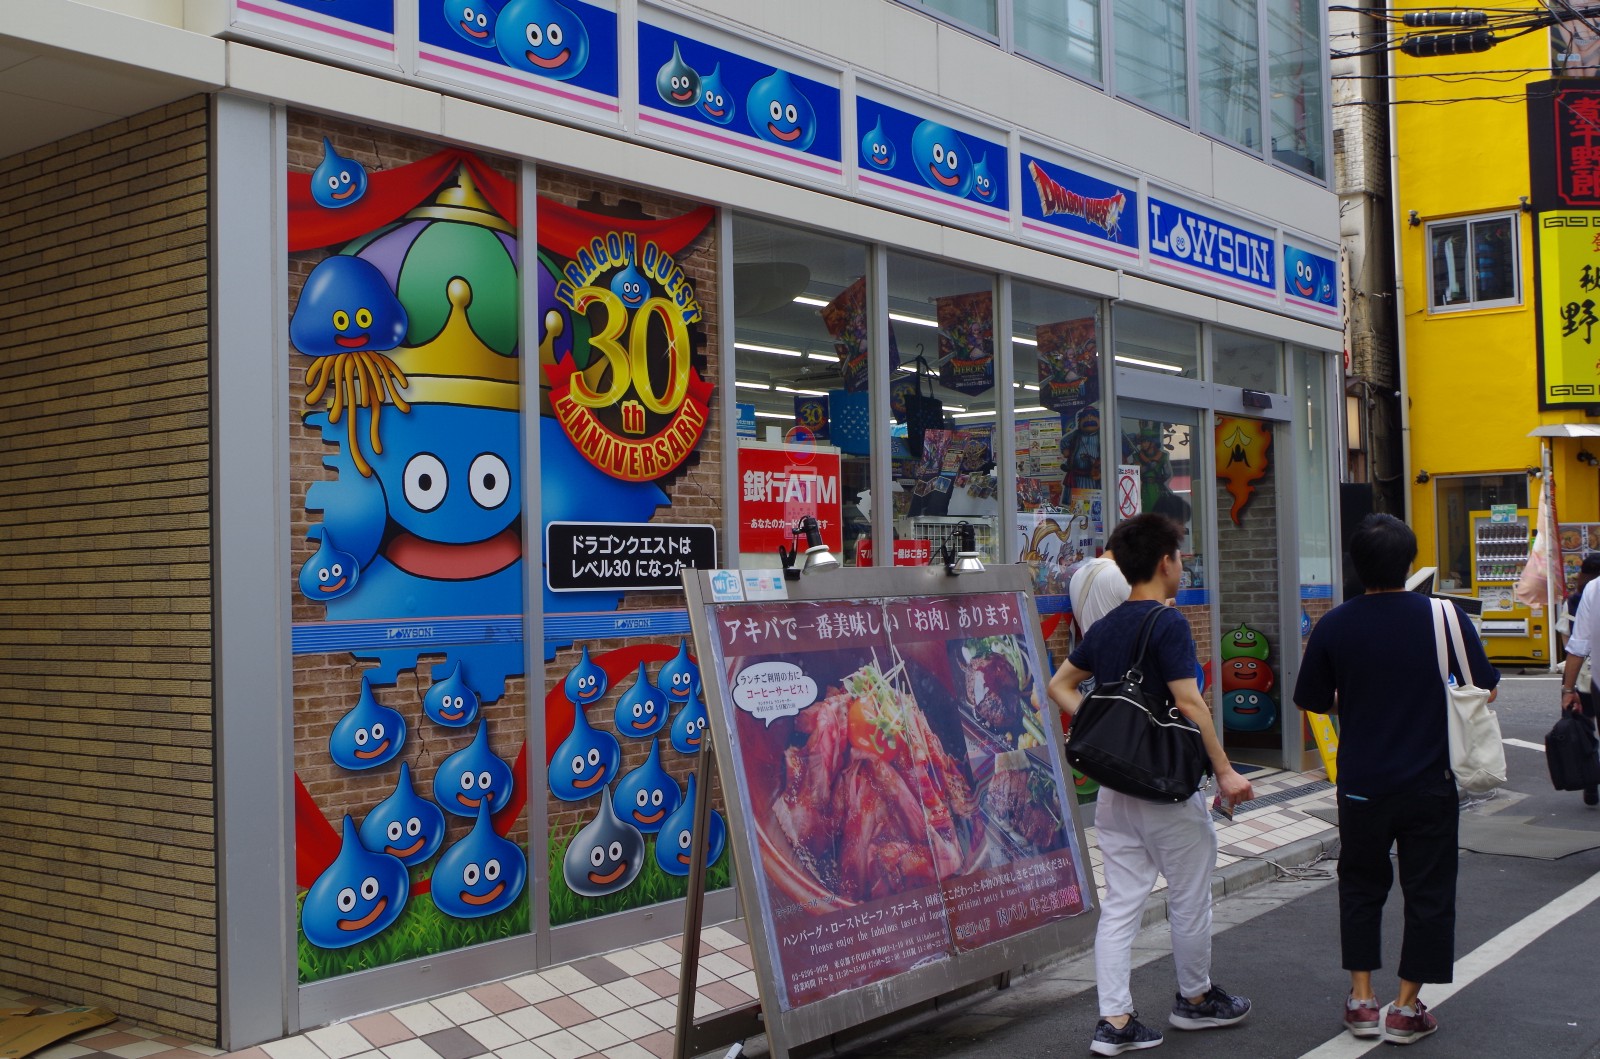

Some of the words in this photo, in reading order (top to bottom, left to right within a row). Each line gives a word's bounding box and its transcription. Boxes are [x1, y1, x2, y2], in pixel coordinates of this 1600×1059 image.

[1028, 160, 1085, 221] DRAGON
[1084, 192, 1126, 242] QUEST
[555, 231, 637, 310] DRAGON
[642, 240, 702, 326] QUEST
[570, 286, 690, 414] 30
[622, 400, 645, 434] th
[556, 398, 704, 478] ANNIVERSARY
[743, 470, 838, 505] 銀行ATM
[751, 518, 828, 530] あなたのカードます
[573, 535, 692, 555] ドラゴンクエストは
[740, 671, 800, 685] ランチご利用の方に
[746, 684, 809, 698] コーヒーサービス！
[811, 943, 834, 956] Please
[836, 936, 854, 948] enjoy
[857, 931, 868, 942] the
[871, 923, 899, 938] fabulous
[900, 917, 917, 929] taste
[920, 912, 927, 922] of
[958, 896, 982, 911] original
